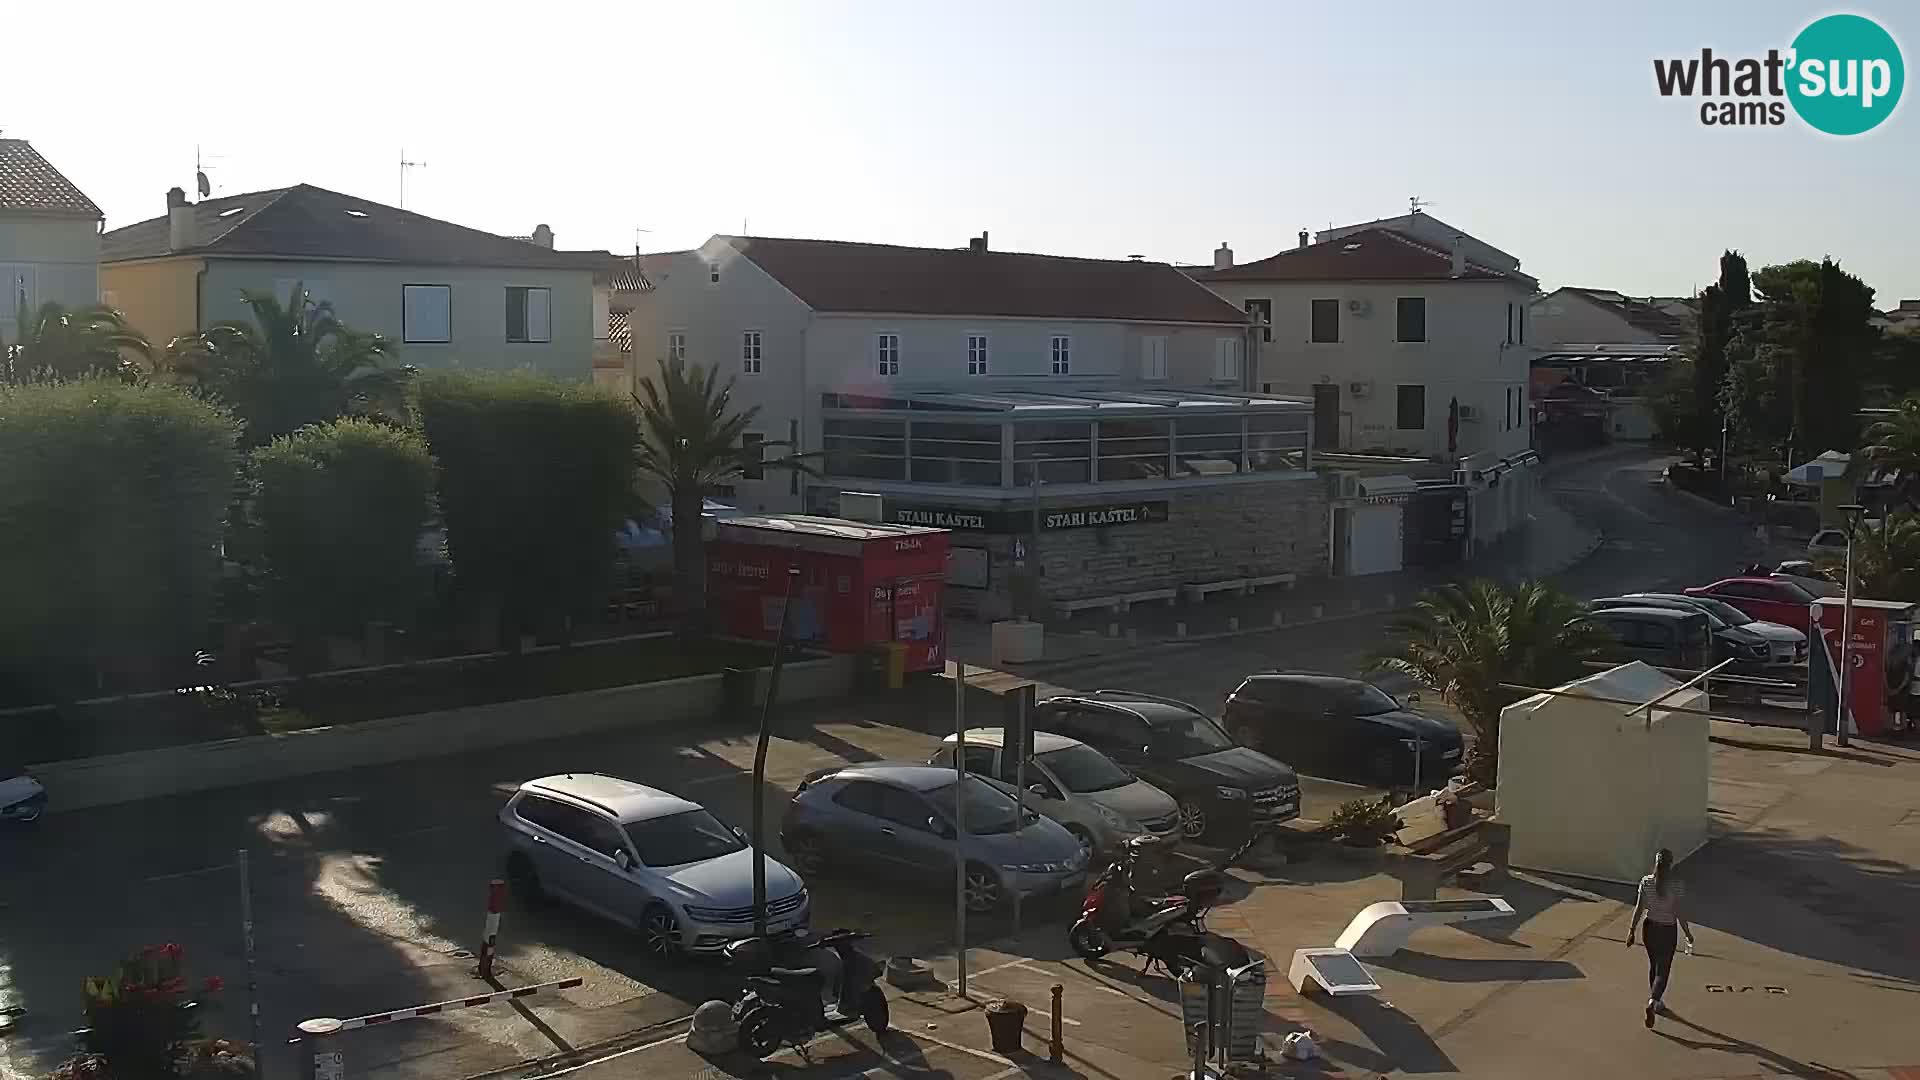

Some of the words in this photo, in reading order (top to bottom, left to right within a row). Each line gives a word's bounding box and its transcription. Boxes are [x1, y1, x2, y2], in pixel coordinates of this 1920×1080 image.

[897, 511, 933, 524] STARI
[1046, 512, 1085, 528] STARI
[874, 587, 893, 601] Buy
